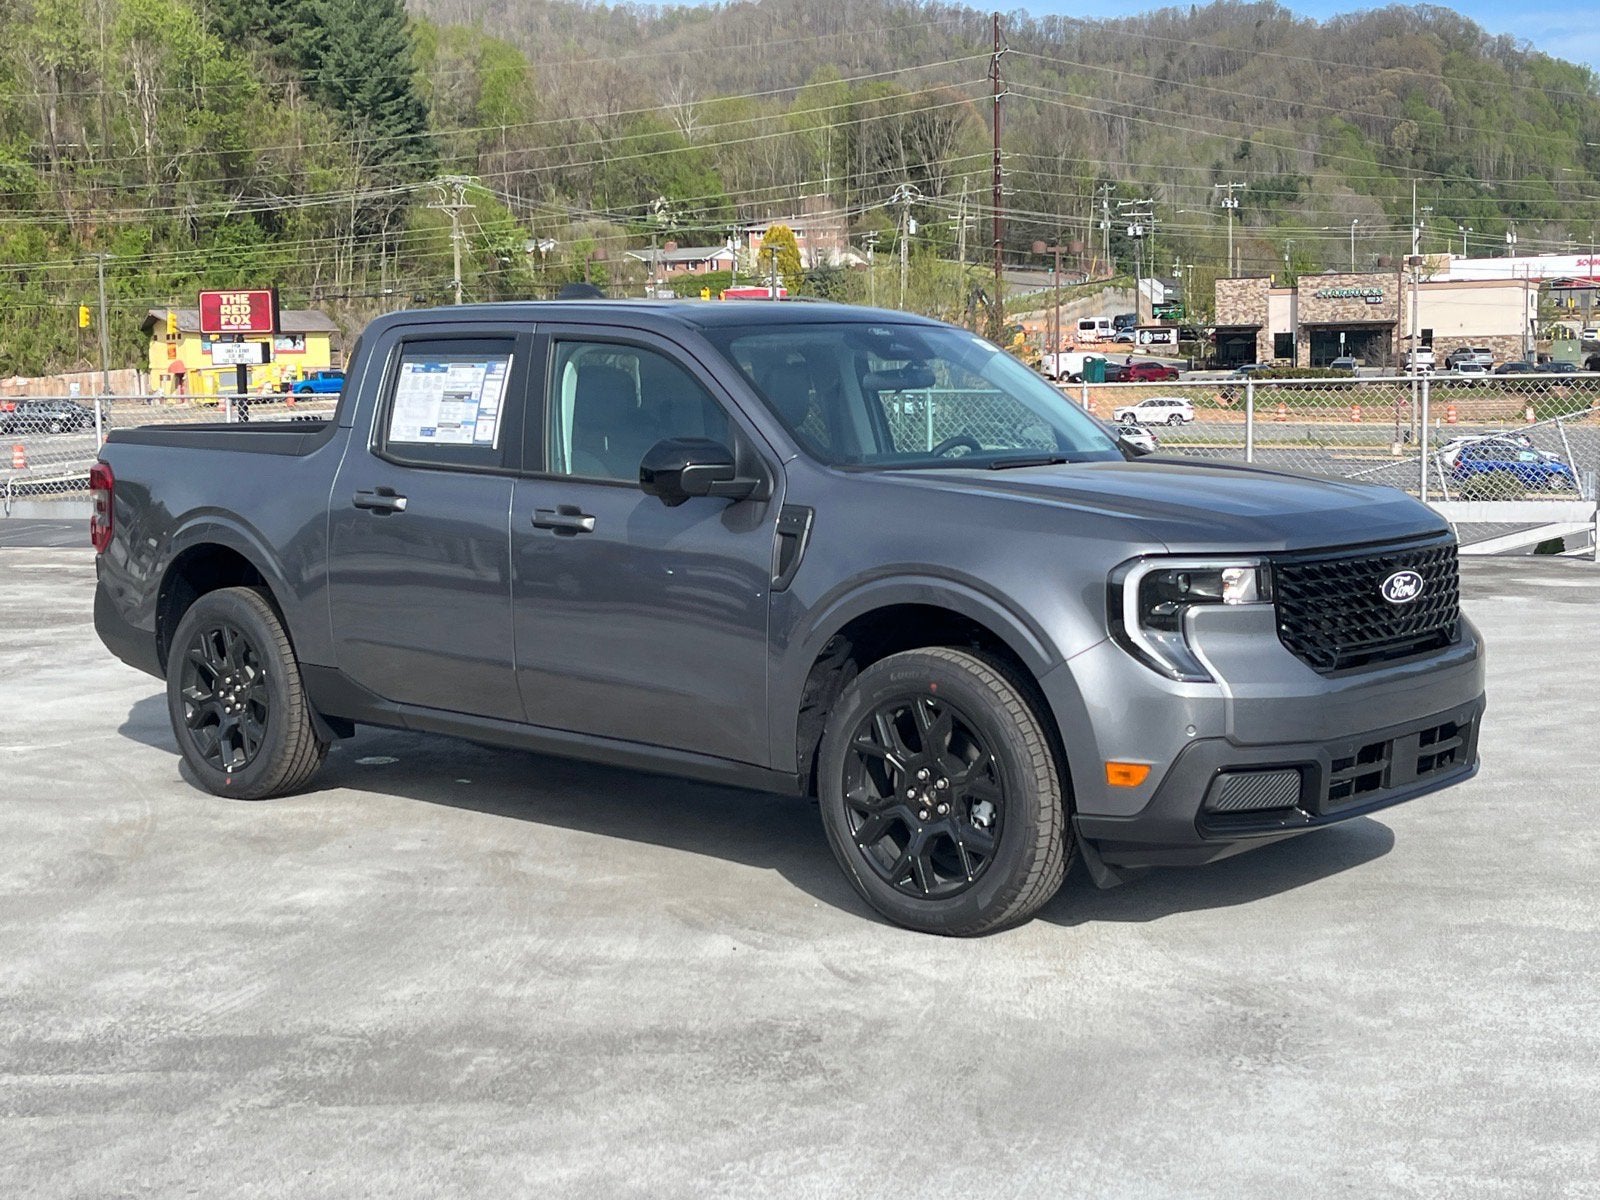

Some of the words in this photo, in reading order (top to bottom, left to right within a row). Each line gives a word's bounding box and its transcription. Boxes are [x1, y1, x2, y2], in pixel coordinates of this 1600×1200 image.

[220, 294, 250, 304] THE
[220, 304, 251, 315] RED
[220, 314, 252, 325] FOX
[1389, 574, 1417, 599] Ford
